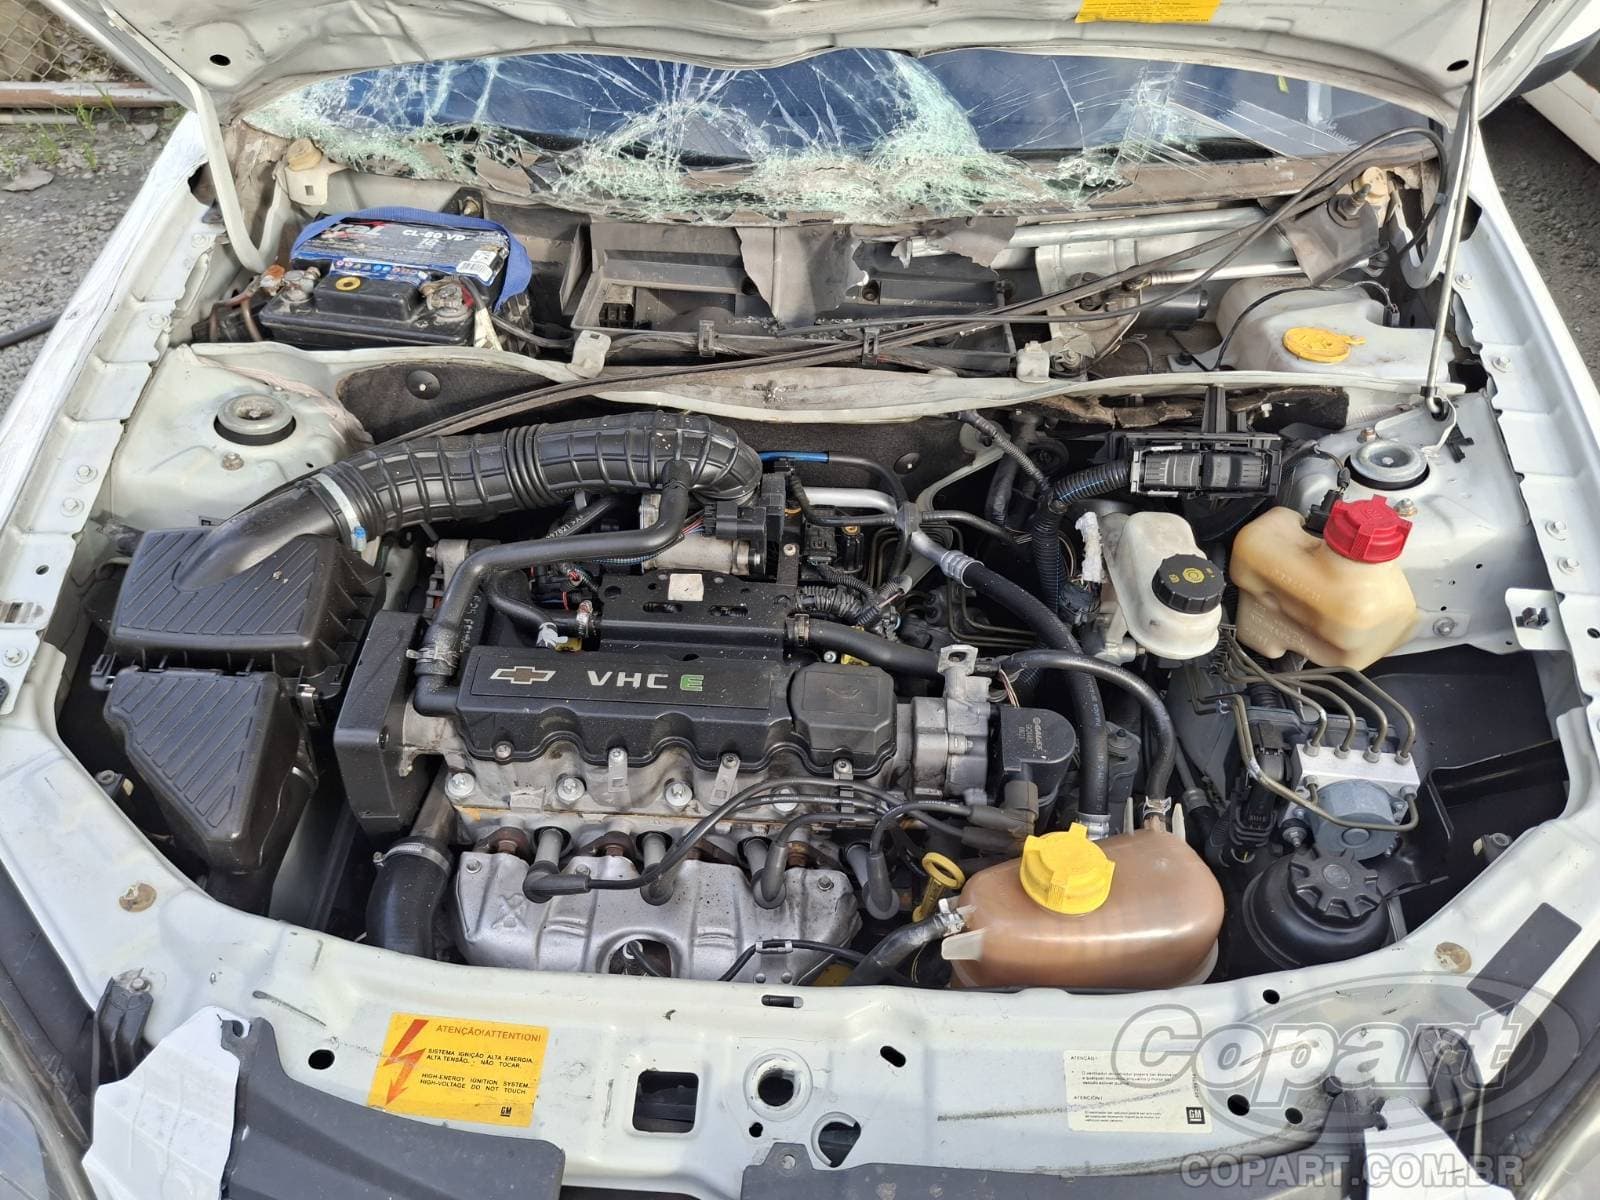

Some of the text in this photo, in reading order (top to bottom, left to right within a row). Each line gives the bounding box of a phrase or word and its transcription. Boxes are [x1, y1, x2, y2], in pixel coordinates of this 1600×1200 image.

[587, 670, 704, 692] VHC E
[428, 1048, 455, 1056] SISTEMA
[458, 1051, 484, 1060] IGNIÇÃO
[480, 1058, 494, 1066] NÃO
[420, 1079, 466, 1089] HIGH-VOLTAGE
[421, 1073, 465, 1083] HIGH-ENERGY
[470, 1077, 498, 1085] IGNITION
[500, 1106, 512, 1116] GM
[1187, 1108, 1203, 1122] GM
